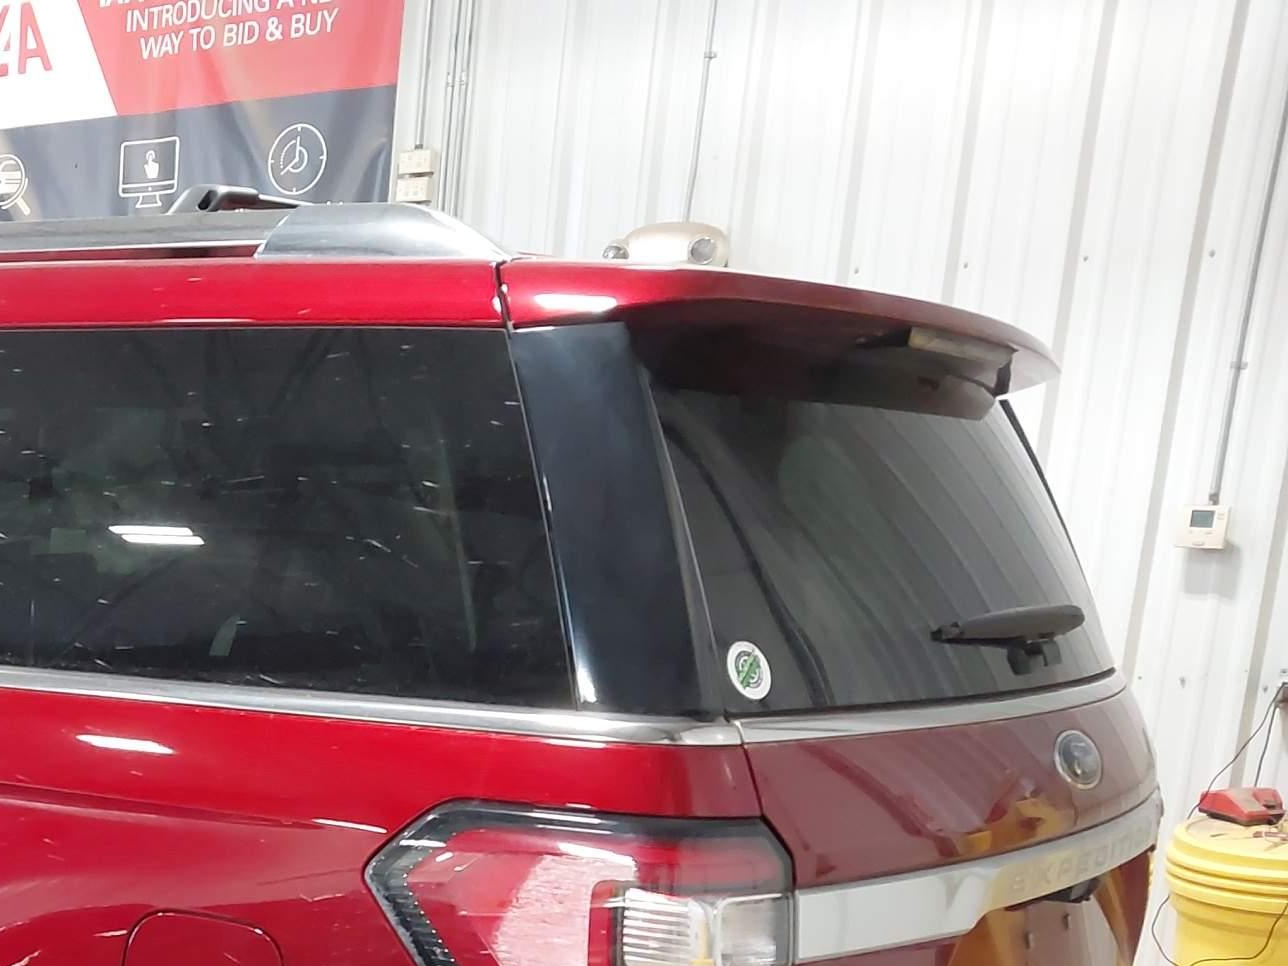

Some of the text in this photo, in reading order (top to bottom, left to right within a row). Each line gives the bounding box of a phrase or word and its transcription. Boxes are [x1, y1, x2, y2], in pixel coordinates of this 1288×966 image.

[125, 0, 270, 33] INTRODUCING
[139, 8, 339, 60] WAY TO BID & BUY
